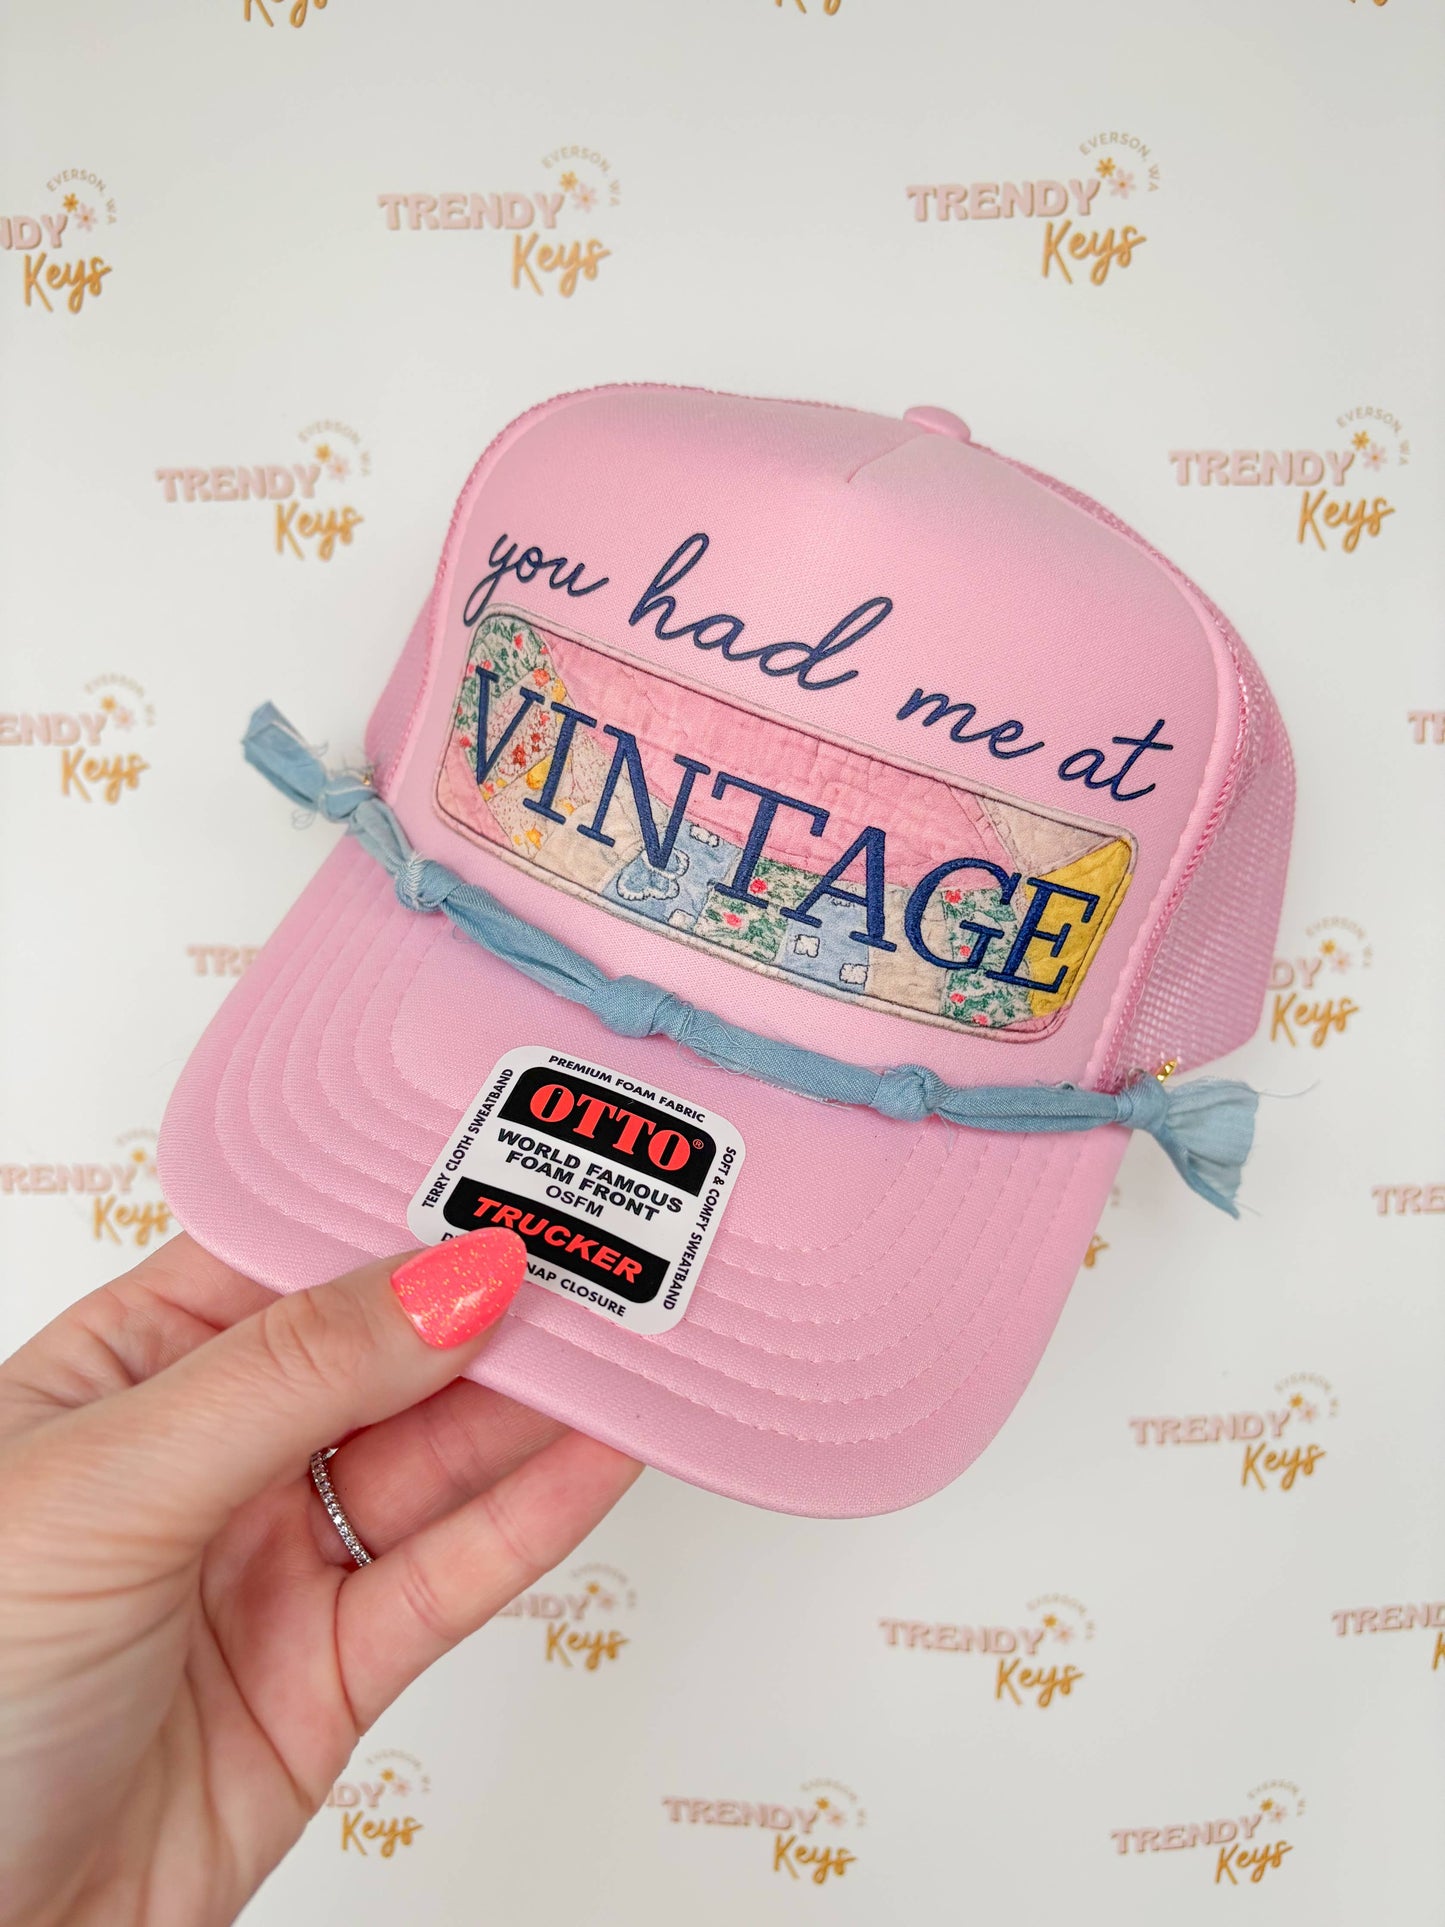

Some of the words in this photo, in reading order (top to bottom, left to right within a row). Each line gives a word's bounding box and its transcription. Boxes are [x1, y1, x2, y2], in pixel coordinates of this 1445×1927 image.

[377, 191, 565, 230] TRENDY
[906, 177, 1101, 222] TRENDY
[512, 231, 611, 298] Keys
[1041, 218, 1147, 286] Keys
[23, 251, 112, 314] Keys
[154, 463, 322, 503] TRENDY
[1168, 449, 1355, 487] TRENDY
[274, 500, 364, 562] Keys
[1297, 488, 1396, 553] Keys
[463, 533, 609, 627] you
[629, 533, 894, 690] had
[896, 688, 1045, 760] me
[1058, 719, 1173, 801] at
[61, 746, 151, 806] Keys
[474, 665, 1101, 994] VINTAGE
[1270, 992, 1360, 1049] Keys
[548, 1055, 613, 1084] PREMIUM
[615, 1078, 655, 1101] FOAM
[658, 1096, 706, 1123] FABRIC
[421, 1173, 451, 1208] TERRY
[446, 1134, 475, 1172] CLOTH
[468, 1068, 514, 1135] SWEATBAND
[719, 1146, 736, 1176] SOFT
[0, 1162, 137, 1196] RENDY
[497, 1128, 581, 1170] WORLD
[586, 1163, 683, 1214] FAMOUS
[505, 1150, 575, 1185] FOAM
[578, 1178, 660, 1222] FRONT
[714, 1176, 725, 1186] &
[545, 1185, 604, 1218] OSFM
[696, 1188, 720, 1232] COMFY
[472, 1196, 643, 1284] TRUCKER
[662, 1231, 703, 1311] SWEATBAND
[560, 1278, 627, 1318] CLOSURE
[1128, 1410, 1290, 1446] TRENDY
[1241, 1442, 1327, 1492] Keys
[545, 1621, 630, 1672] Keys
[878, 1617, 1045, 1656] TRENDY
[995, 1657, 1084, 1709] Keys
[340, 1810, 424, 1860] Keys
[662, 1795, 820, 1835] TRENDY
[1111, 1812, 1263, 1855] TRENDY
[772, 1833, 858, 1886] Keys
[1214, 1839, 1294, 1886] Keys
